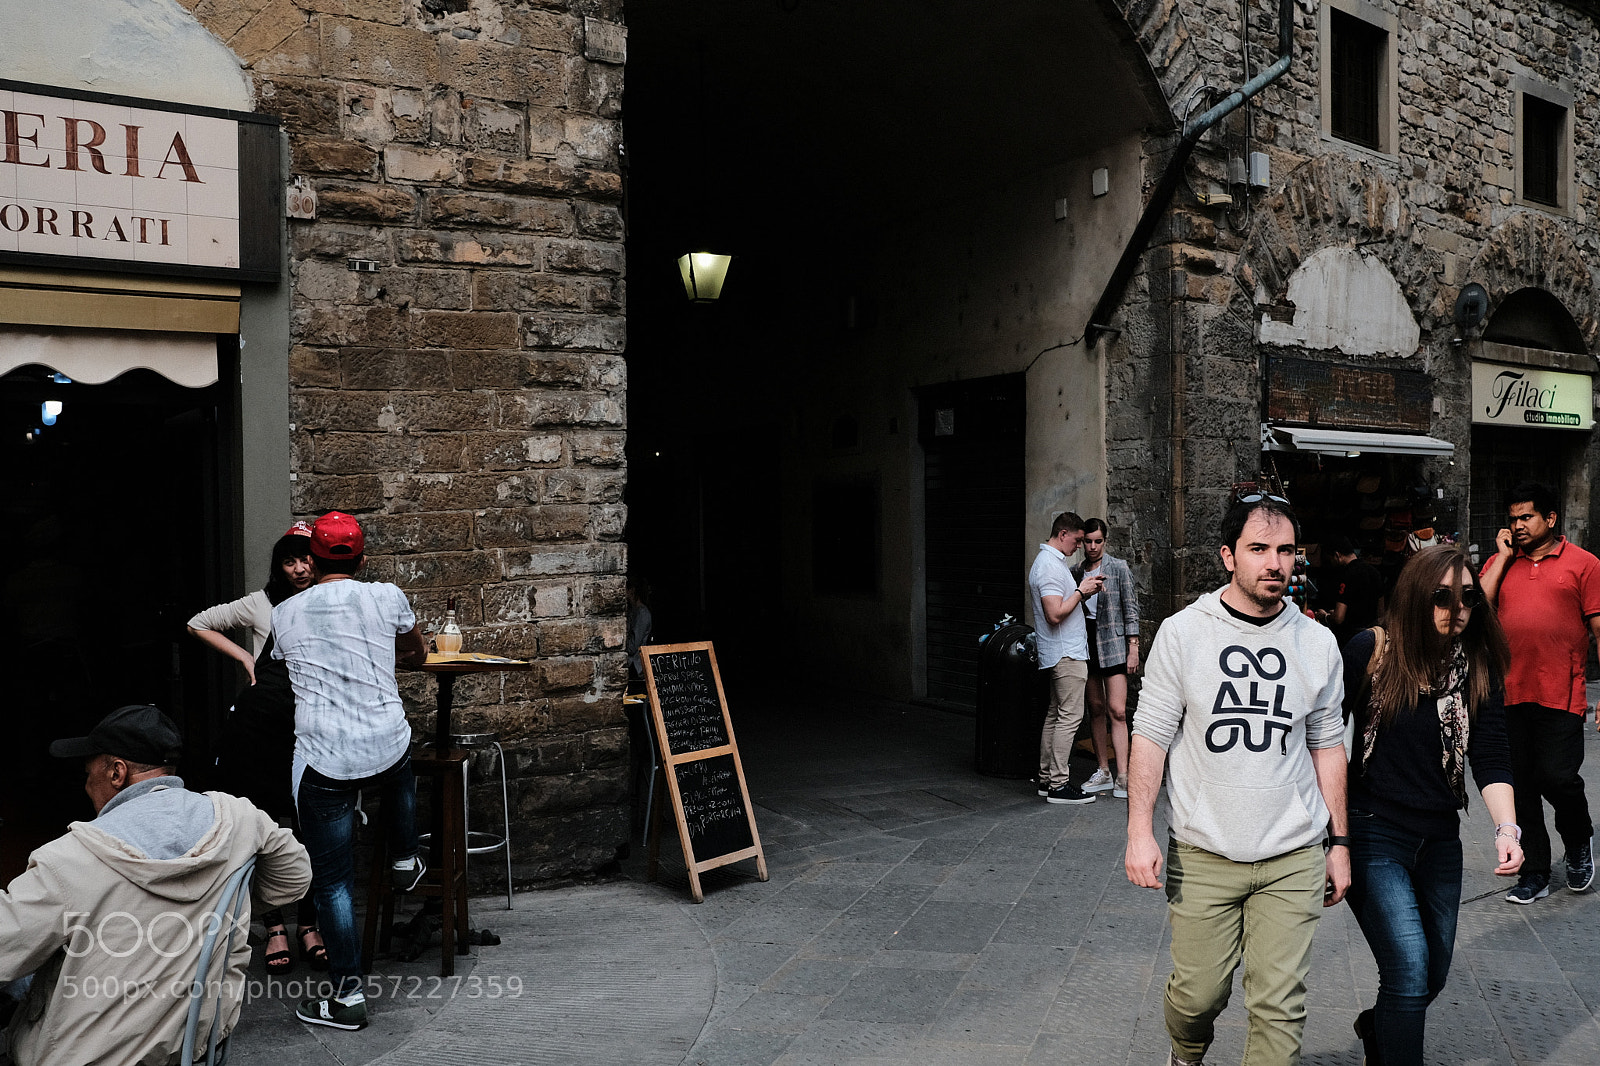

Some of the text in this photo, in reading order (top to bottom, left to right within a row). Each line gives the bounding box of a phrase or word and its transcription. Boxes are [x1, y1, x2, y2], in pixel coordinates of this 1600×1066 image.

[0, 109, 206, 184] ERIA
[288, 194, 313, 214] 30
[1486, 370, 1557, 418] Filaci
[1526, 413, 1579, 425] studio immobiliare
[1219, 645, 1287, 680] GO
[1211, 681, 1292, 719] ALL
[1205, 718, 1292, 756] OUT
